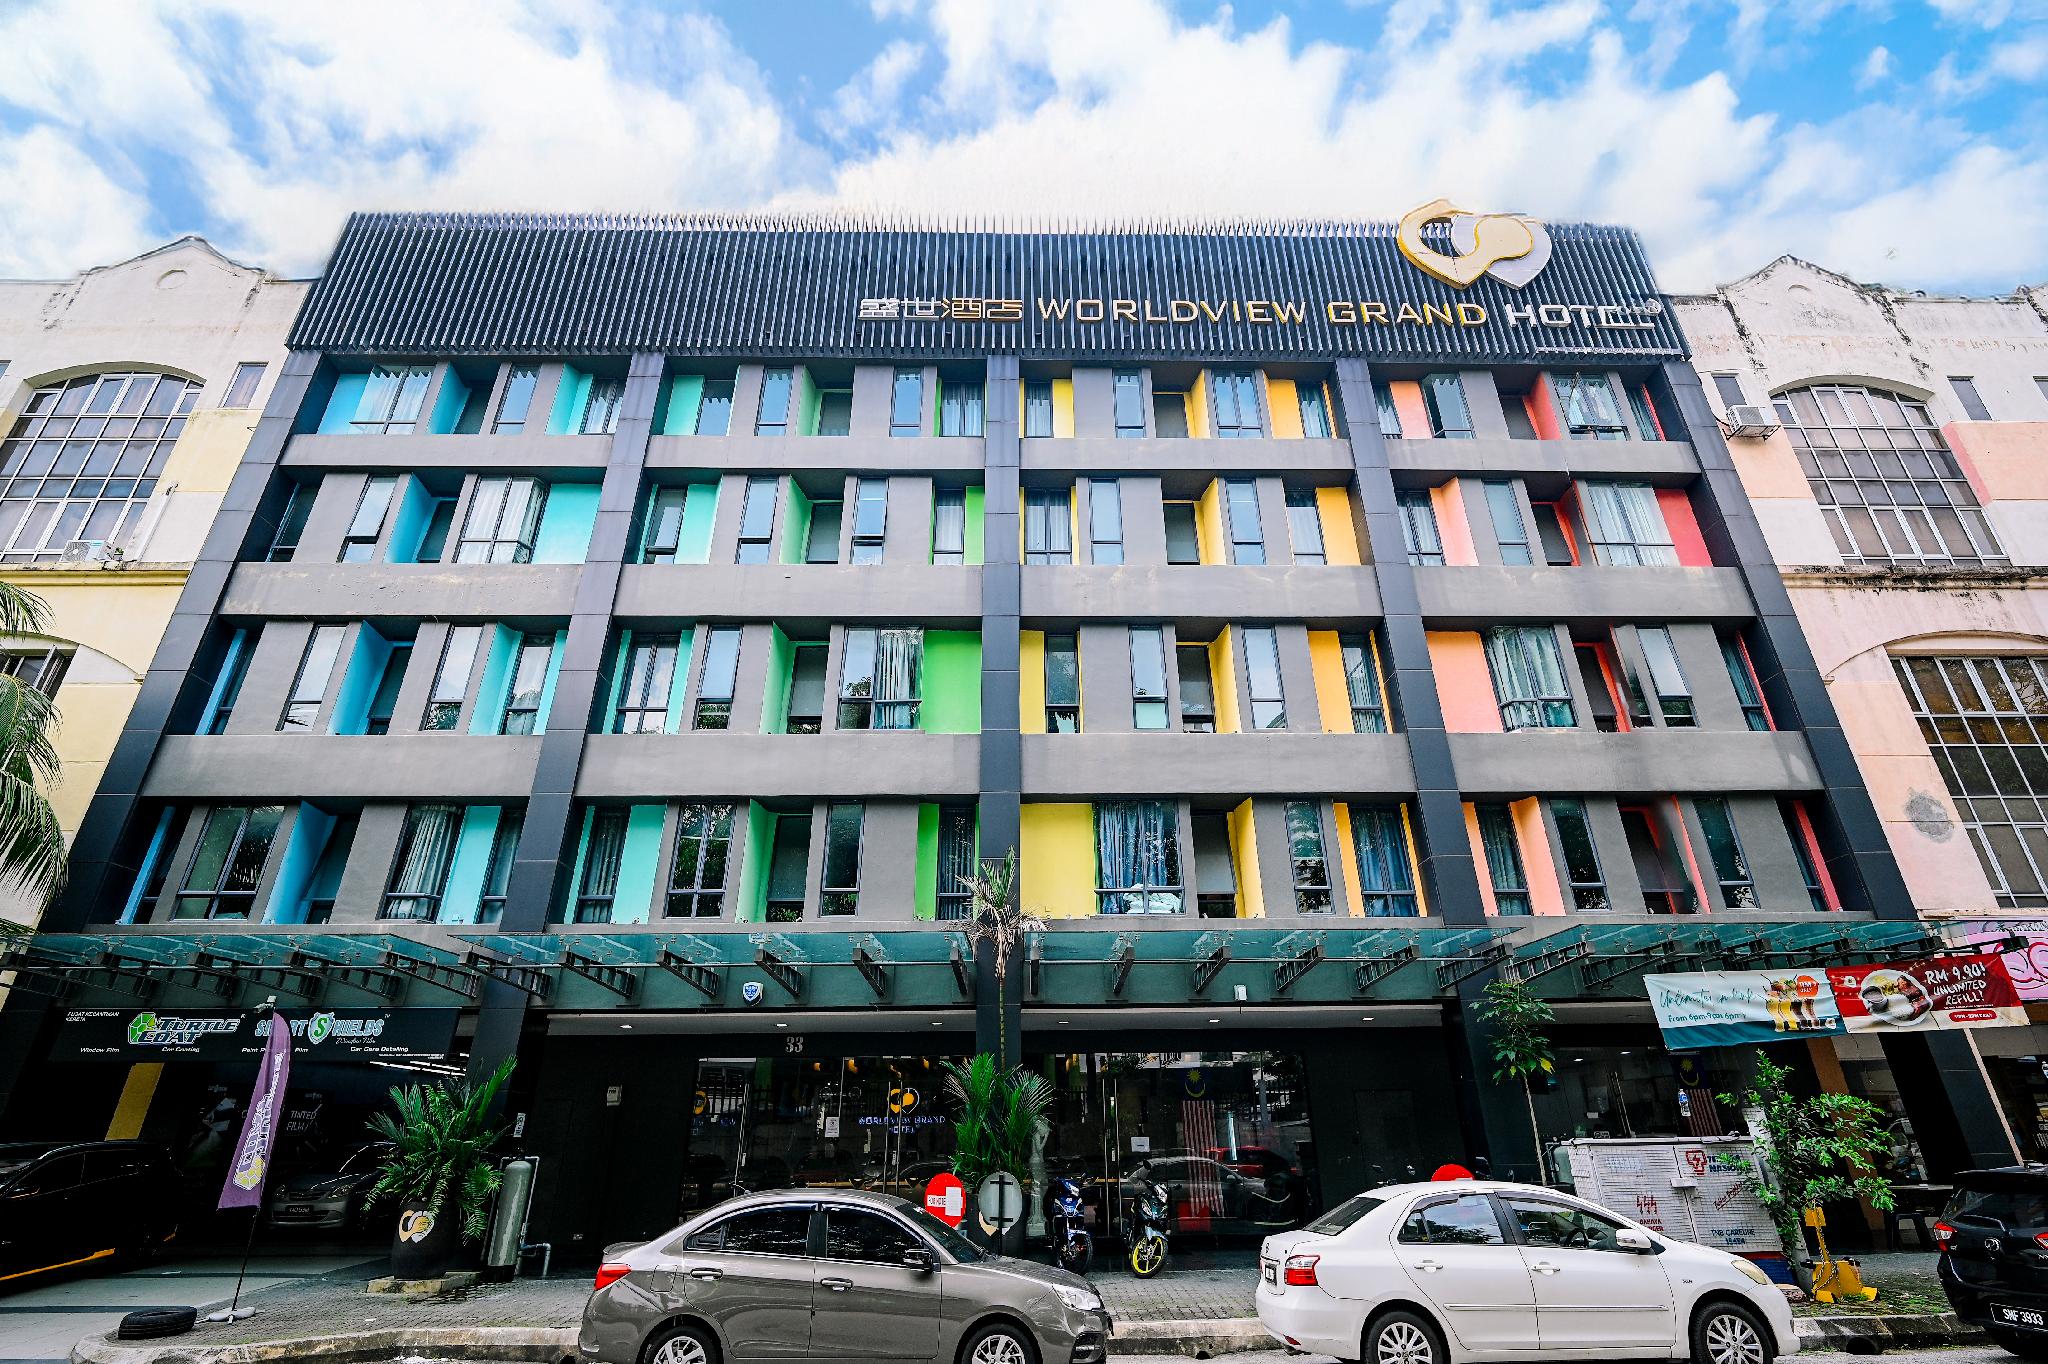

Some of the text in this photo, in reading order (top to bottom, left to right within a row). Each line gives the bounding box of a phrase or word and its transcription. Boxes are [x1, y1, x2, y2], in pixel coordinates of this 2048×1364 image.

[858, 297, 1023, 320] 盛世酒店
[1037, 297, 1306, 324] WORLDVIEW
[1327, 301, 1488, 327] GRAND
[1924, 961, 1986, 984] RM 9.90!
[1933, 979, 1987, 996] UNLIMITED
[1945, 989, 1985, 1006] REFILL!
[158, 1016, 241, 1034] TURTLE
[1668, 1013, 1688, 1023] From
[136, 1030, 203, 1045] COAT
[785, 1036, 804, 1053] 33
[290, 1110, 317, 1120] TINTED
[2019, 1311, 2044, 1326] 3933
